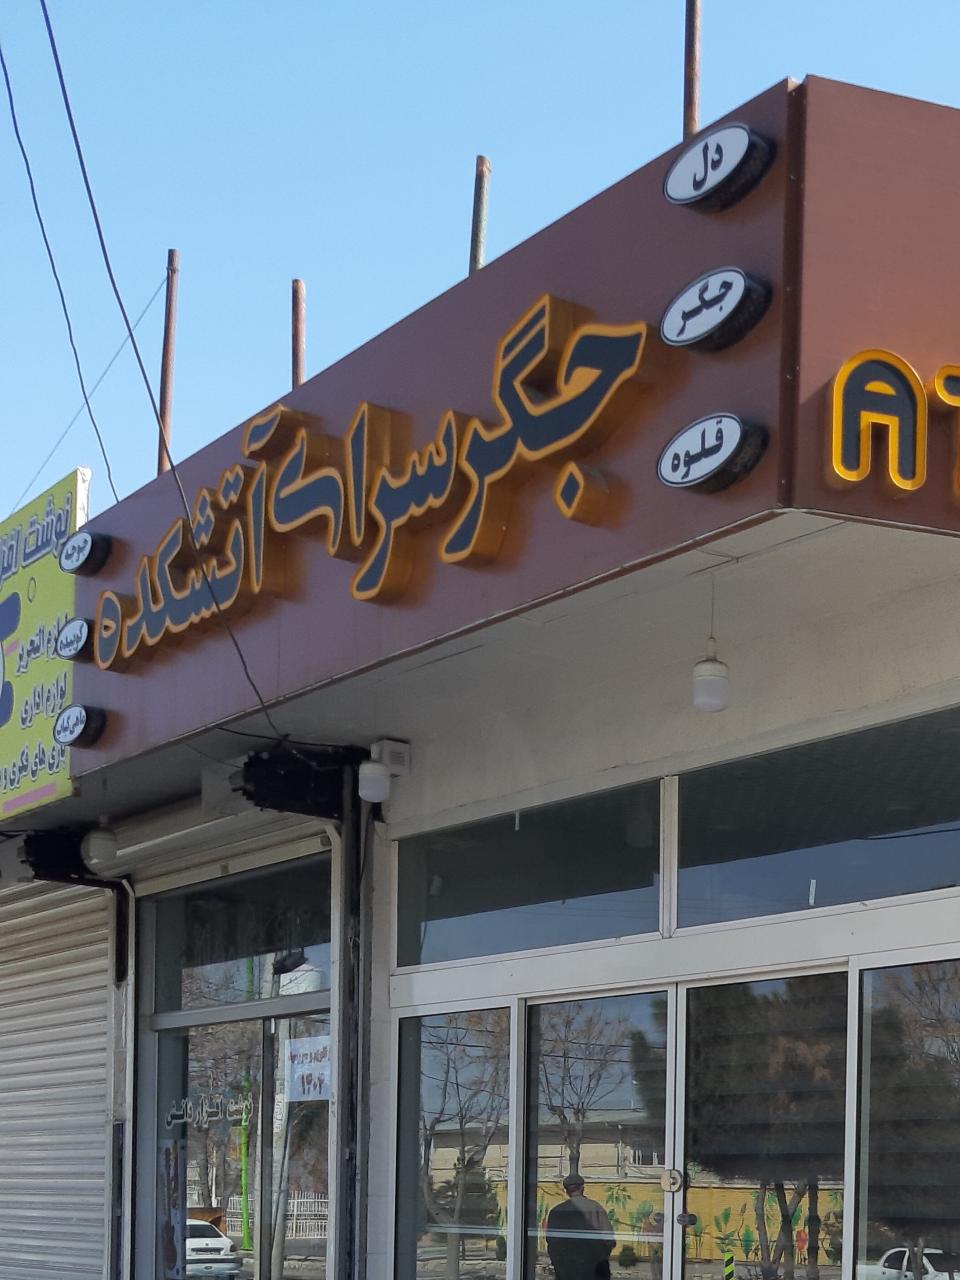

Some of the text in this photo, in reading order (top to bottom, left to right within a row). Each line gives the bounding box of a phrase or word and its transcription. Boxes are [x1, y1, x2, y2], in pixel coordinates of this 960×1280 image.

[691, 142, 724, 192] دل
[675, 276, 734, 338] جگر
[670, 418, 725, 481] قلوه
[22, 492, 72, 568] نوشت
[94, 402, 290, 671] آتشکده
